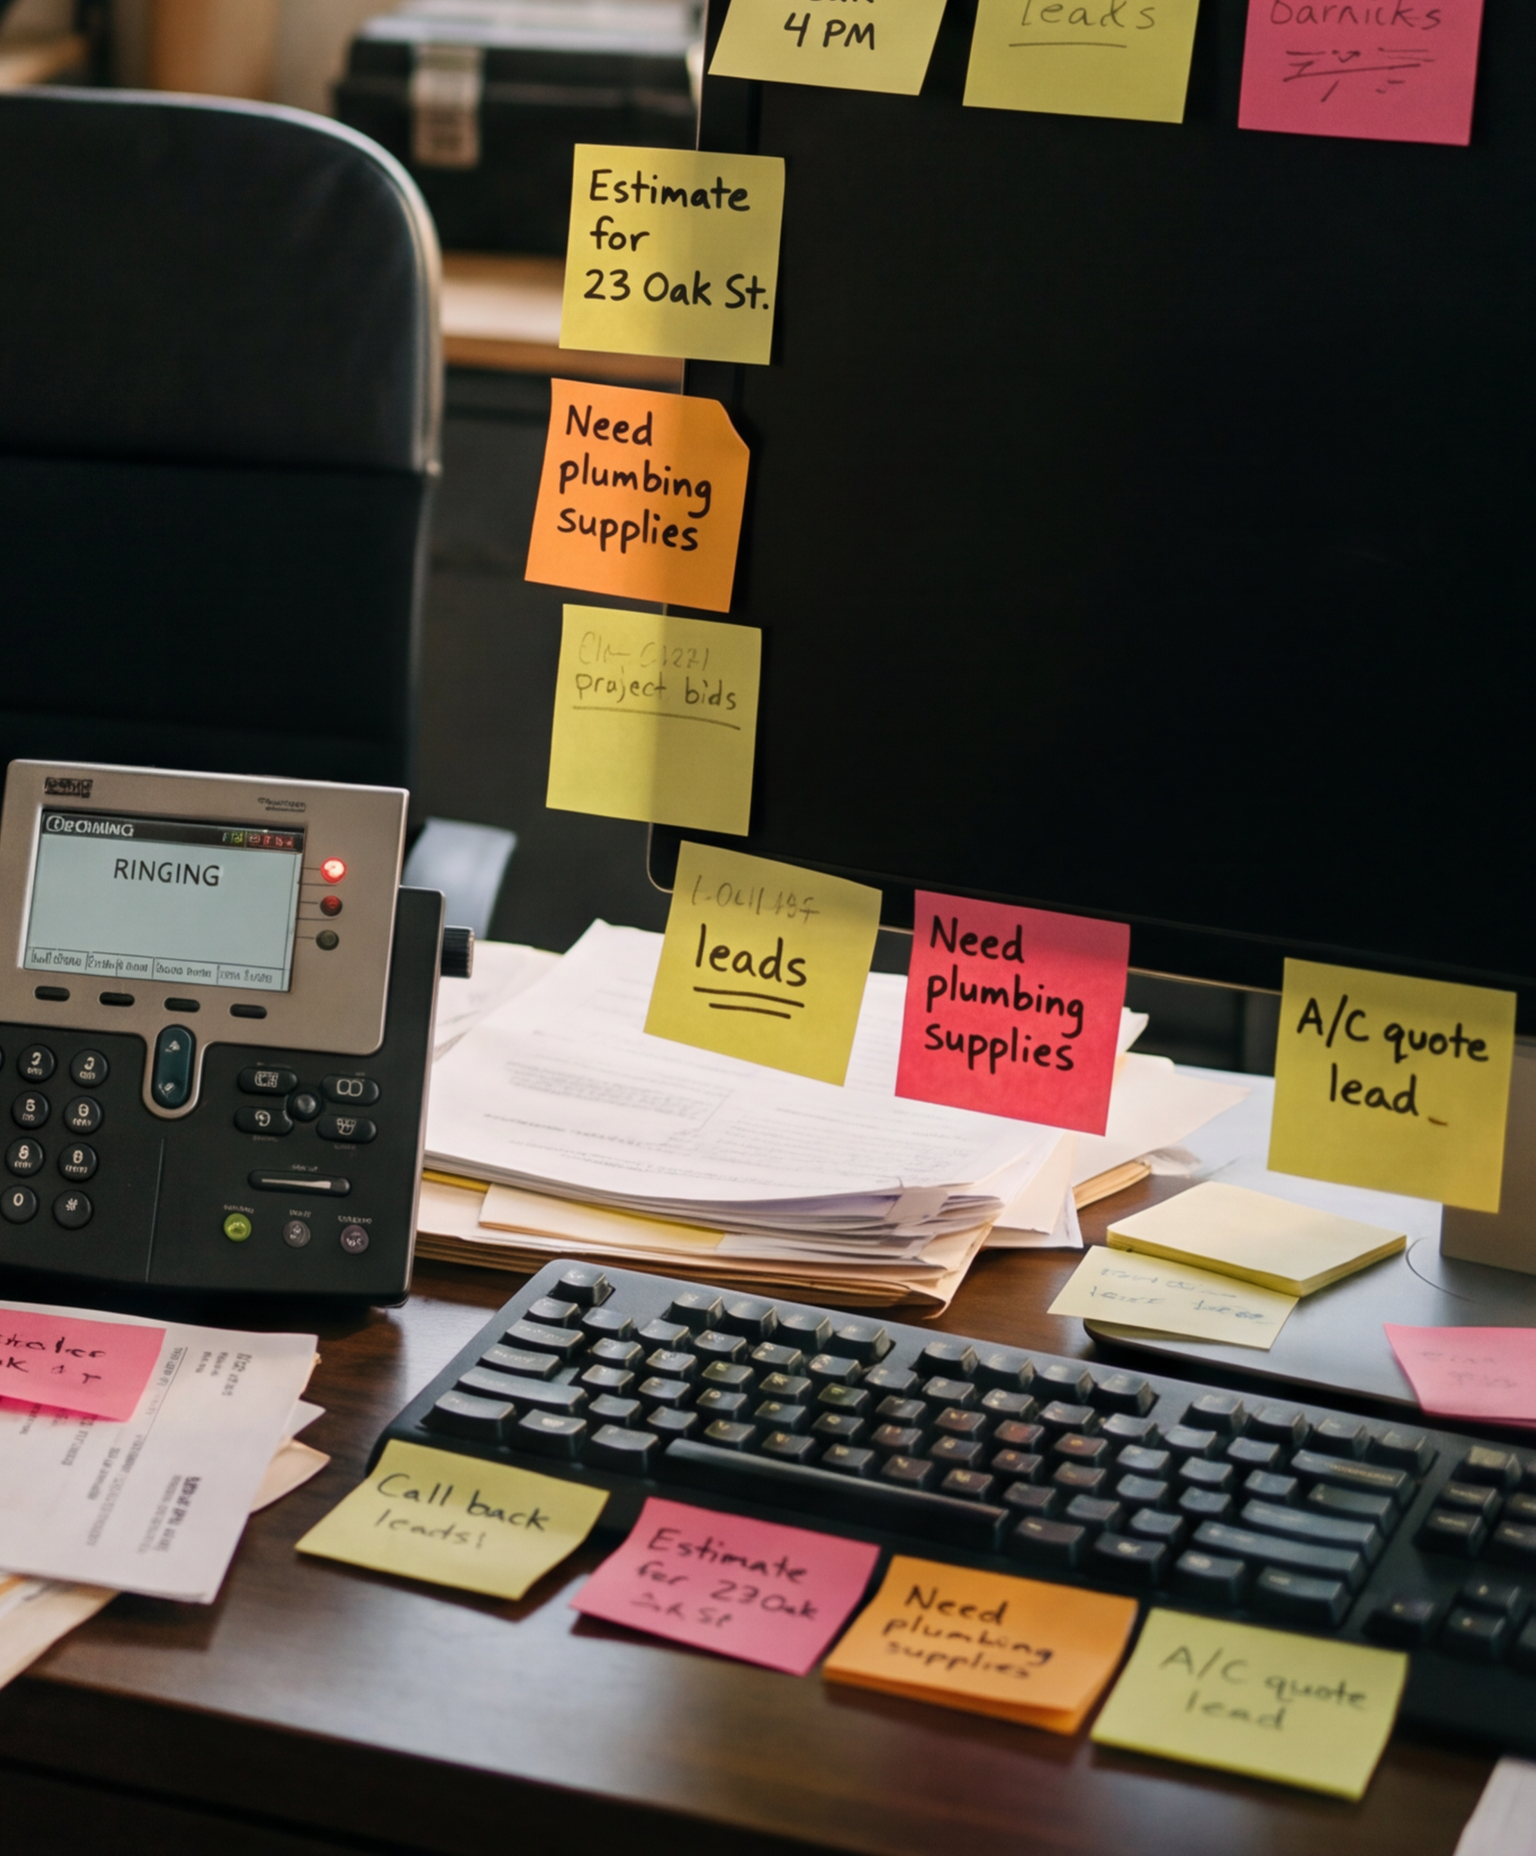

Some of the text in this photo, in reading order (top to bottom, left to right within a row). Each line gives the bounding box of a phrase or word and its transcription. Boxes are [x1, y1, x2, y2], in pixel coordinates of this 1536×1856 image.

[784, 12, 875, 51] 4 PM
[589, 168, 751, 212] Estimate
[589, 215, 650, 252] for
[583, 268, 770, 310] 23 Oak St.
[565, 404, 653, 447] Need
[559, 452, 712, 519] plumbing
[557, 507, 699, 555] supplies
[684, 676, 737, 710] bids
[113, 858, 221, 887] RINGING
[695, 923, 807, 987] leads
[930, 915, 1025, 964] Need
[926, 964, 1084, 1039] plumbing
[924, 1023, 1075, 1075] supplies
[1296, 994, 1489, 1064] A/C quote
[13, 1193, 24, 1206] 0
[377, 1473, 550, 1532] Call back
[648, 1527, 808, 1584] Estimate
[904, 1584, 1009, 1626] Need
[882, 1615, 1054, 1667] plumbing
[1159, 1645, 1368, 1710] A/C quote
[1185, 1690, 1287, 1731] lead
